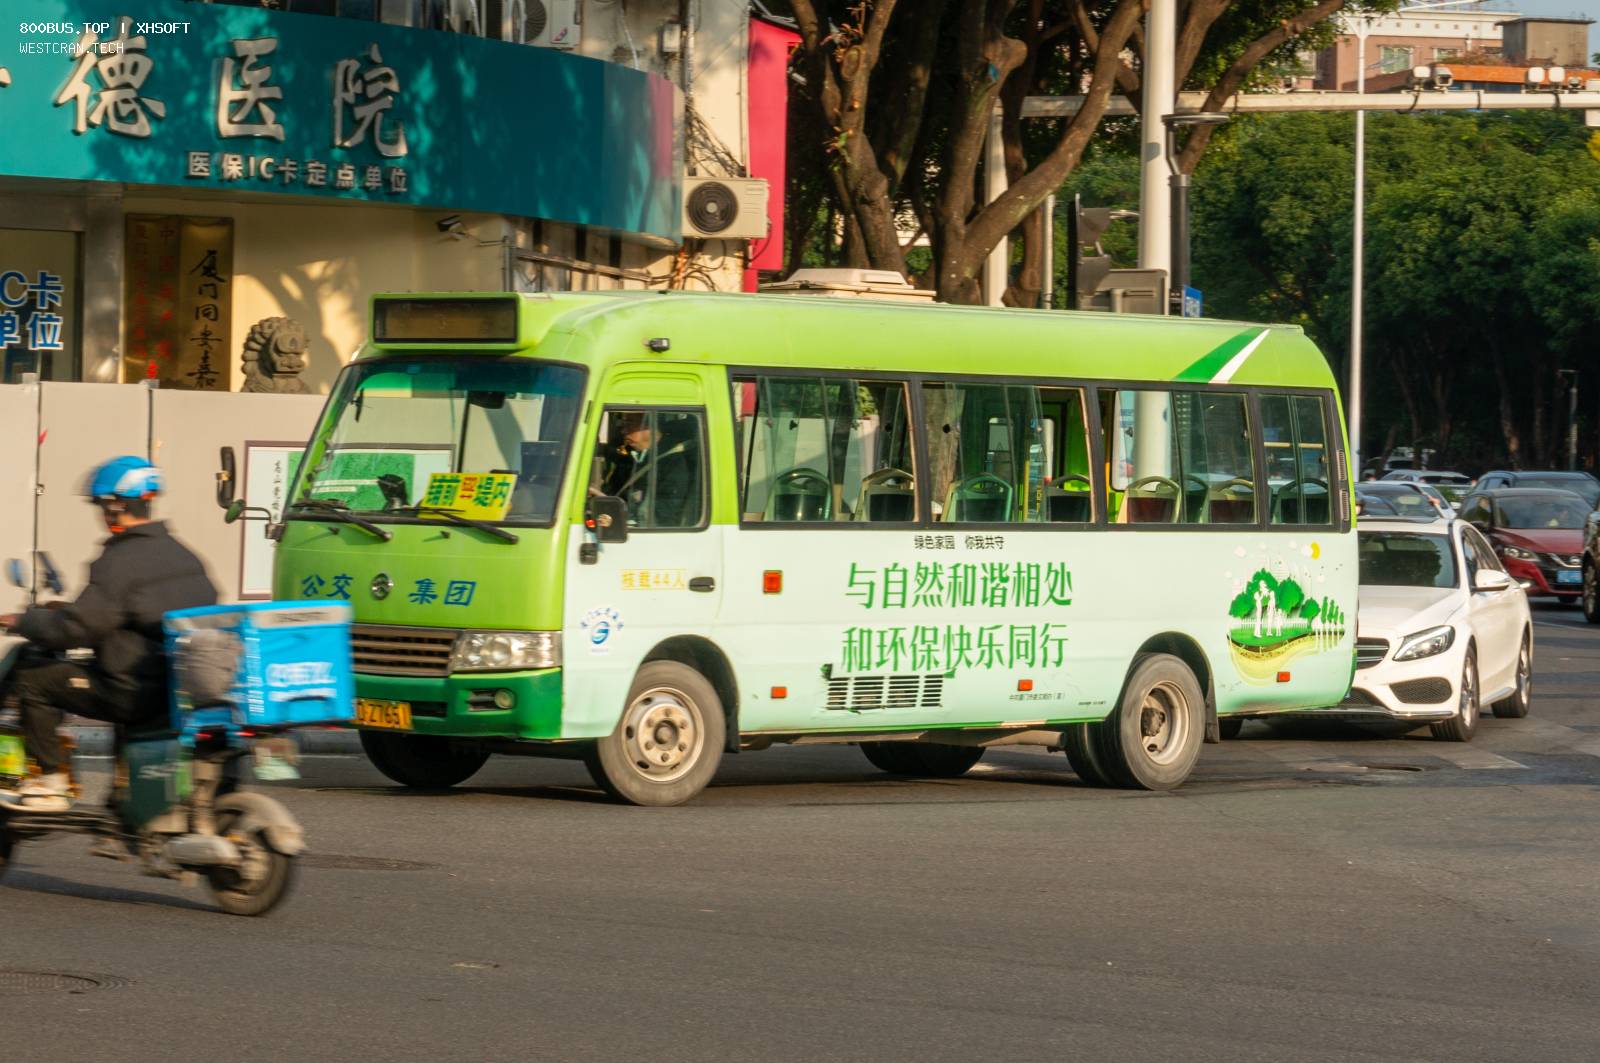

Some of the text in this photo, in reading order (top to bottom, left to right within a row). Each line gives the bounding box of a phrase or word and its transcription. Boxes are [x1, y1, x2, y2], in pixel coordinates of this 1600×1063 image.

[0, 15, 409, 158] 德医院
[188, 151, 408, 193] 医保IC卡定点单位
[914, 535, 1005, 550] 绿色家园 你我共守
[301, 573, 477, 606] 公交 集团
[845, 561, 1073, 609] 与自然和谐相处
[841, 623, 1069, 672] 和环保快乐同行
